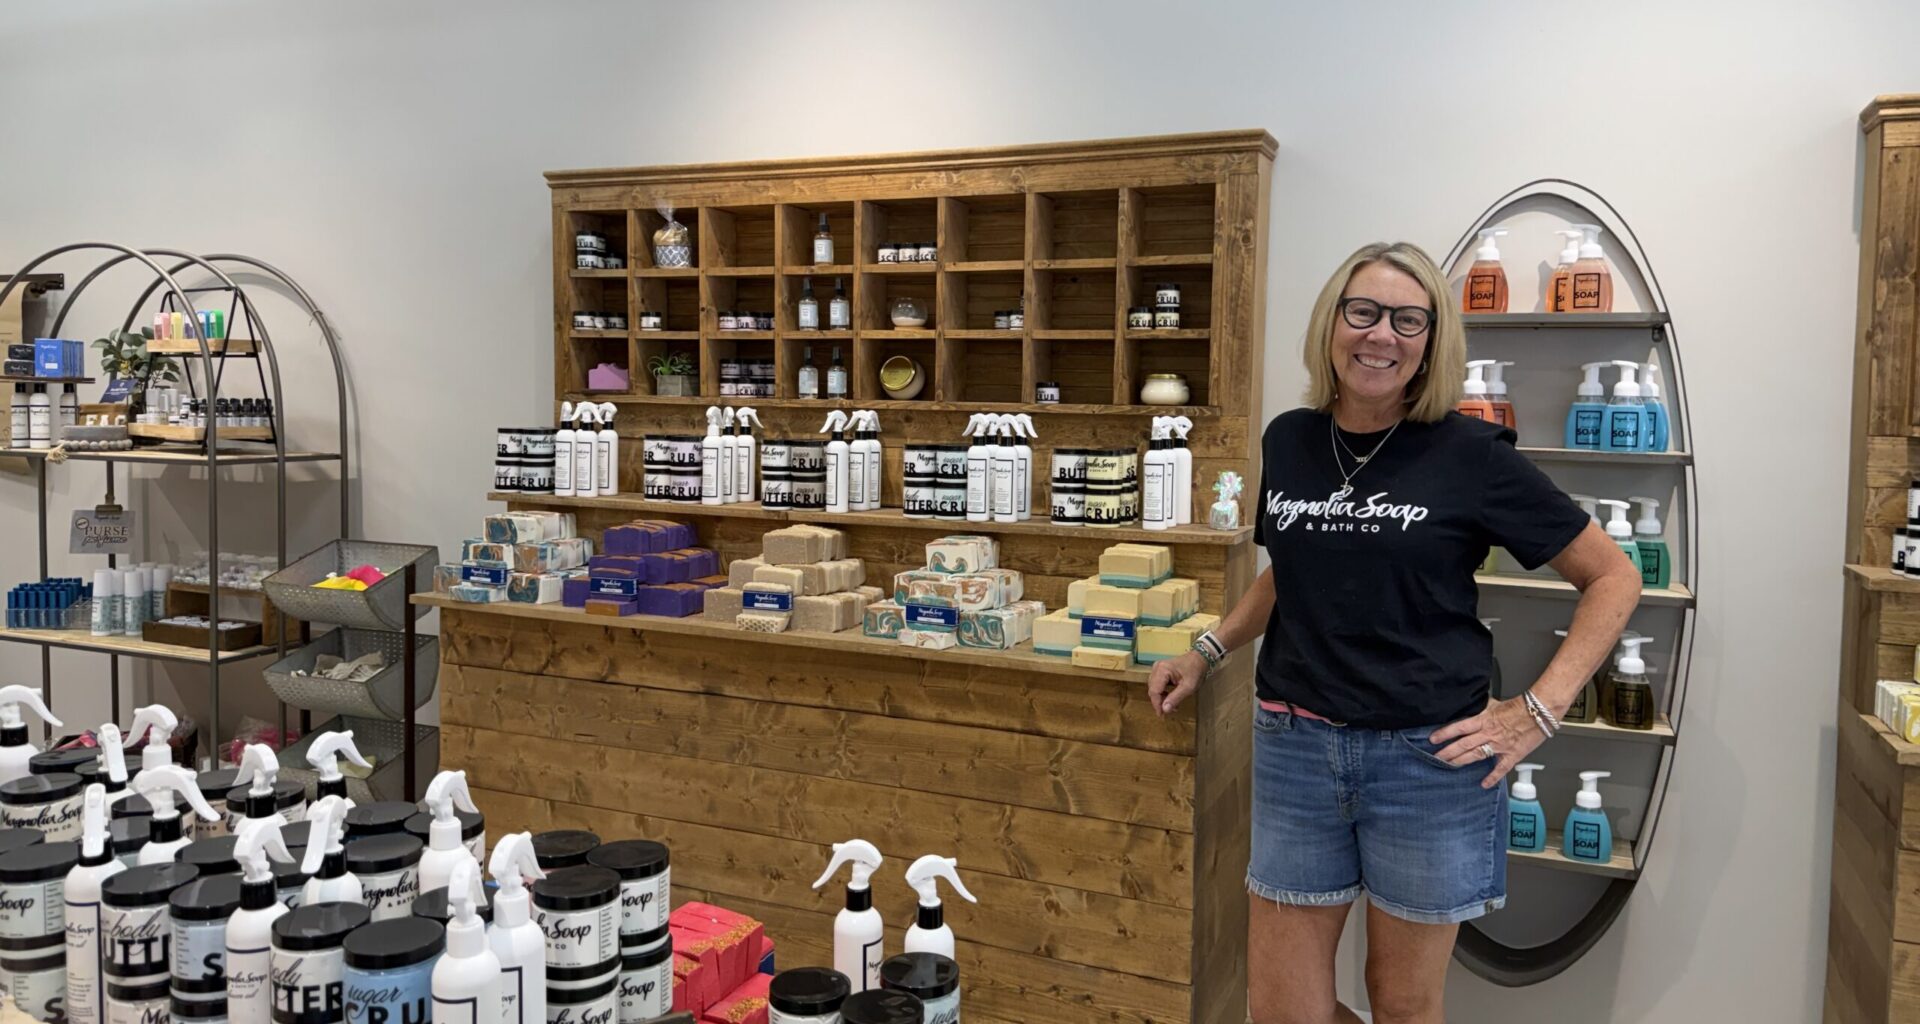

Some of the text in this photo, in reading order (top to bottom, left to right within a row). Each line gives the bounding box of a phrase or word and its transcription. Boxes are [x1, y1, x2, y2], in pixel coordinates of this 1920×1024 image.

[1472, 292, 1495, 301] SOAP
[1574, 291, 1600, 300] SOAP
[1576, 428, 1601, 436] SOAP
[1612, 430, 1638, 438] SOAP
[670, 452, 696, 464] RUB
[1267, 488, 1429, 531] Magnolia Soap
[85, 525, 129, 536] PURSE
[1305, 522, 1380, 533] & BATH CO
[1511, 830, 1535, 840] SOAP
[1574, 839, 1600, 849] SOAP
[362, 870, 414, 911] agnolia
[111, 910, 162, 945] body
[549, 919, 592, 945] Soap
[103, 934, 170, 964] UTT
[619, 977, 656, 1001] Soap
[273, 979, 343, 1013] TTER
[345, 997, 426, 1024] CRU
